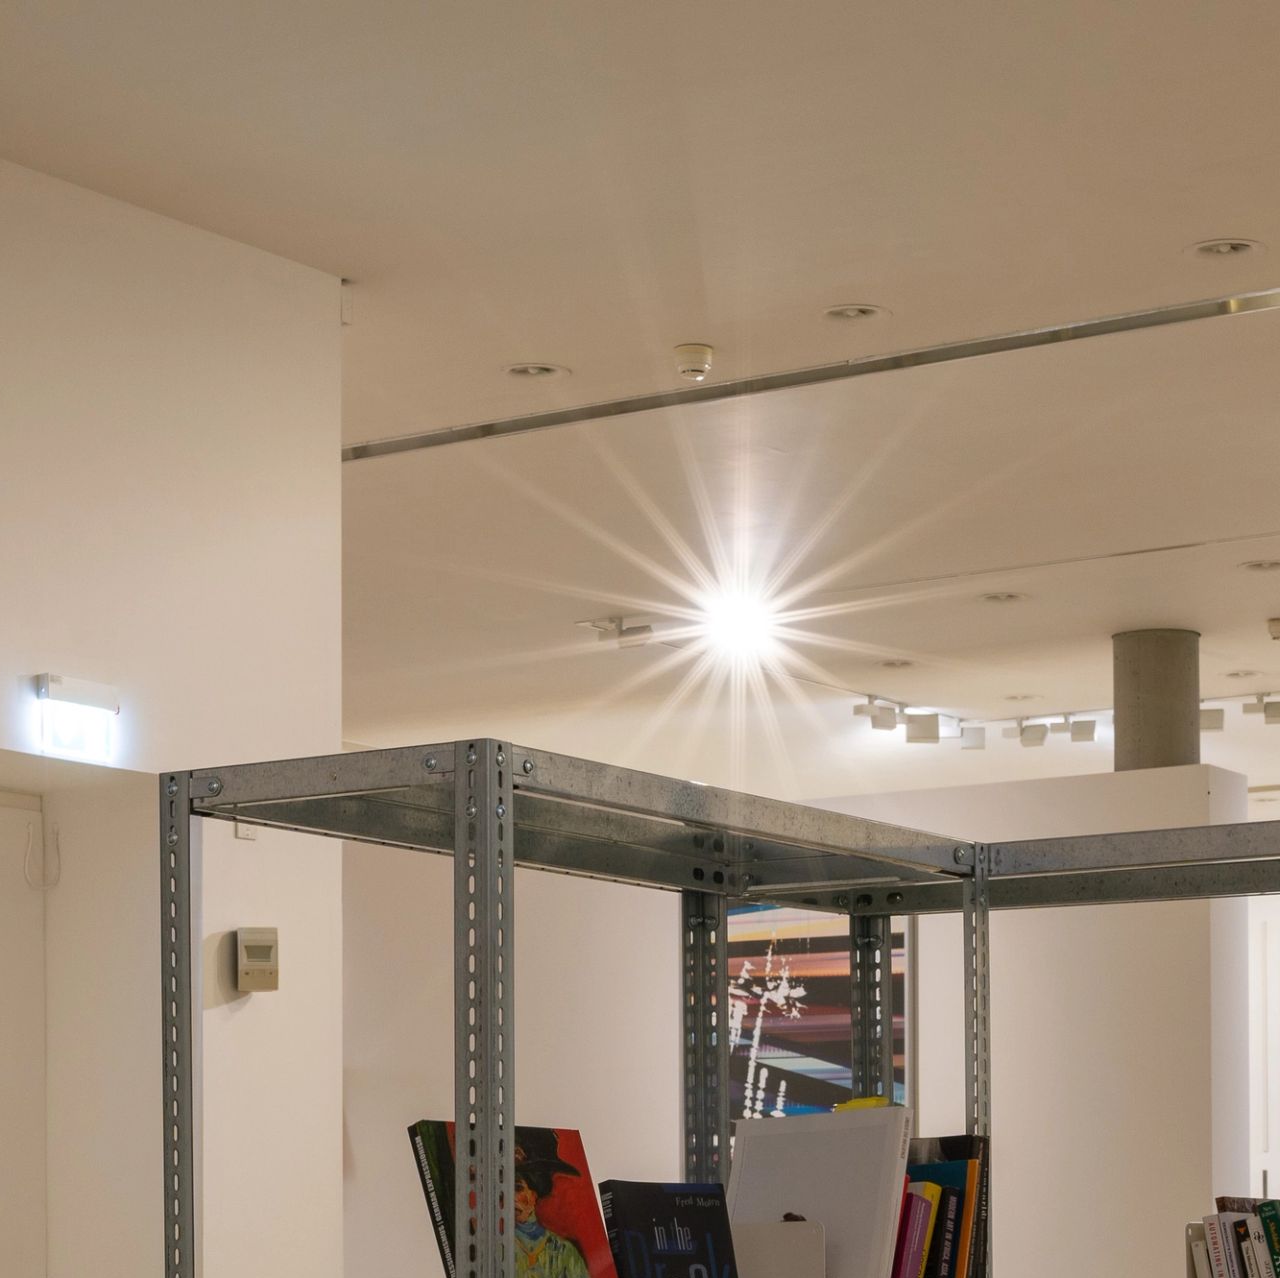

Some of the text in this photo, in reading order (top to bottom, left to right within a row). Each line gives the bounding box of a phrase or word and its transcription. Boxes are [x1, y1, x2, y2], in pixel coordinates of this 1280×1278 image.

[675, 1197, 694, 1207] Fred
[947, 1195, 958, 1219] MODERN
[653, 1217, 693, 1250] in the
[946, 1220, 955, 1231] ART
[1207, 1222, 1221, 1268] AUTOMATING
